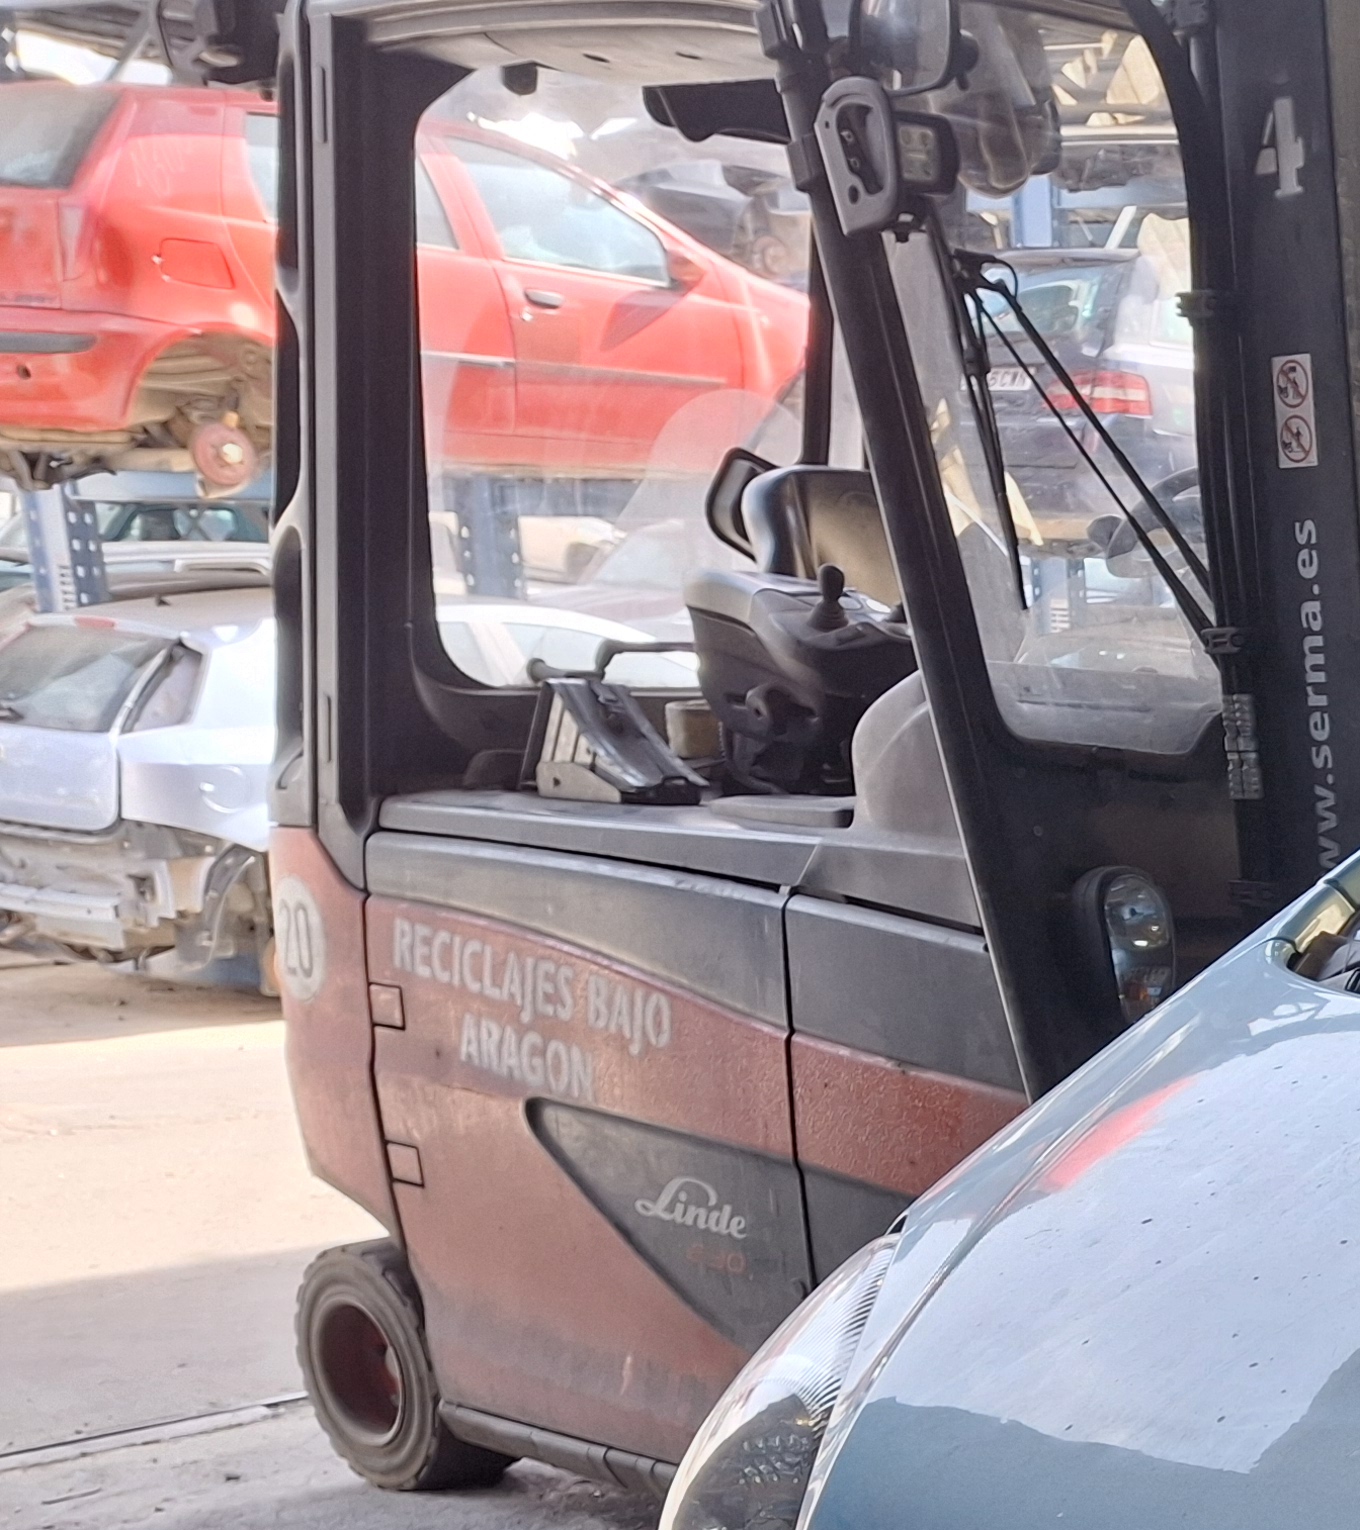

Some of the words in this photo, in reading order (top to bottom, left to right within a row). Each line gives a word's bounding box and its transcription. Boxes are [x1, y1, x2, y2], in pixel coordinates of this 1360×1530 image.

[1254, 96, 1304, 198] 4
[1294, 518, 1342, 870] ww.serma.es
[277, 898, 314, 979] 20
[392, 916, 576, 1026] RECICLAJES
[585, 972, 673, 1058] BAJO
[459, 1012, 595, 1101] ARAGON
[634, 1176, 748, 1239] Linde
